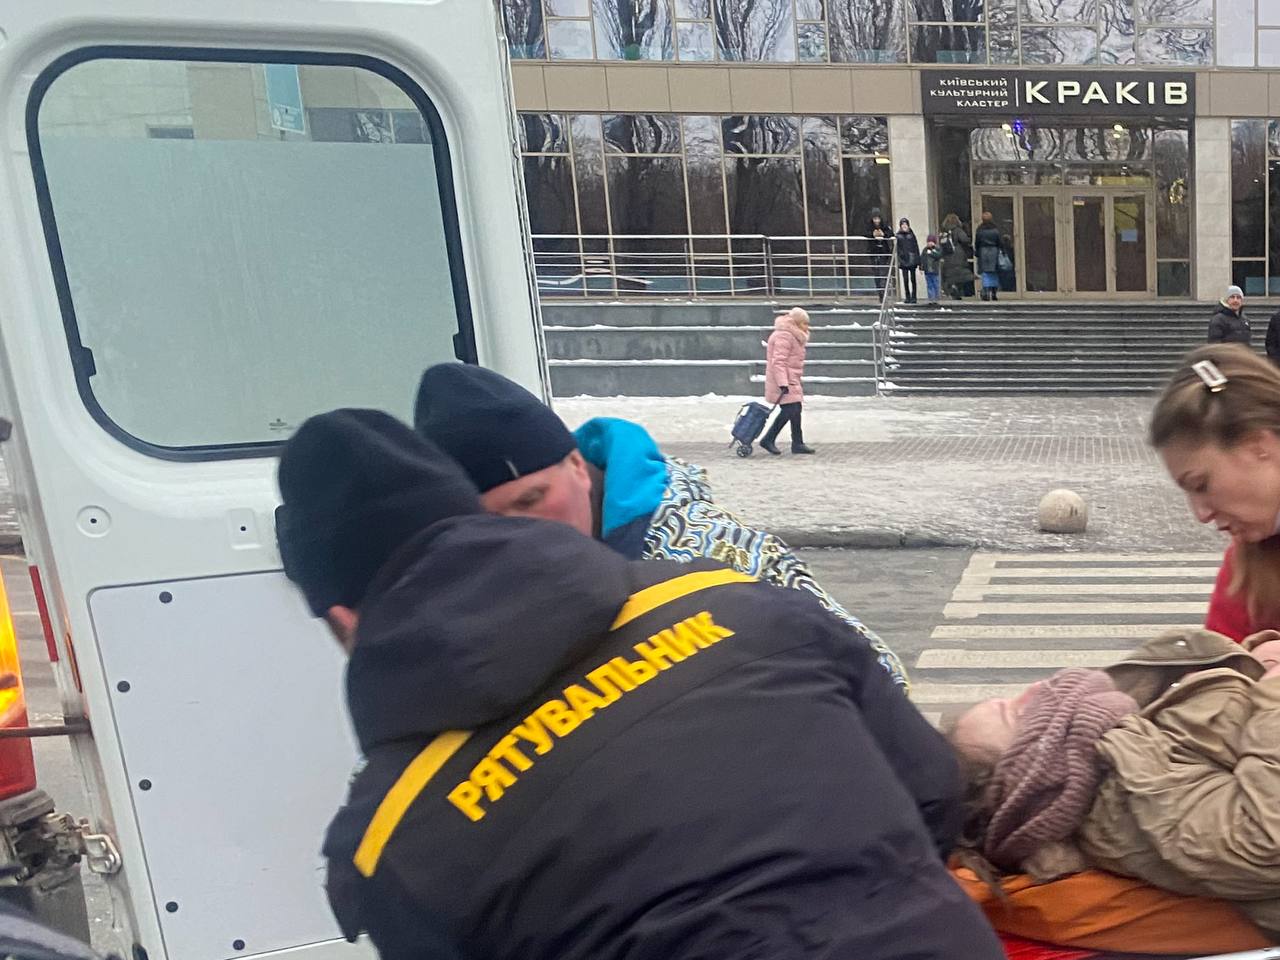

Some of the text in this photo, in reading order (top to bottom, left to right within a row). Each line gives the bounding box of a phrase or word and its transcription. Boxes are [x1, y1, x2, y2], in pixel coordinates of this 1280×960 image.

[939, 77, 1008, 86] КИЇВСЬКИЙ
[930, 88, 1008, 97] КУЛЬТУРНИЙ
[1025, 80, 1189, 105] КРАКІВ
[446, 610, 736, 822] РЯТУВАЛЬНИК
